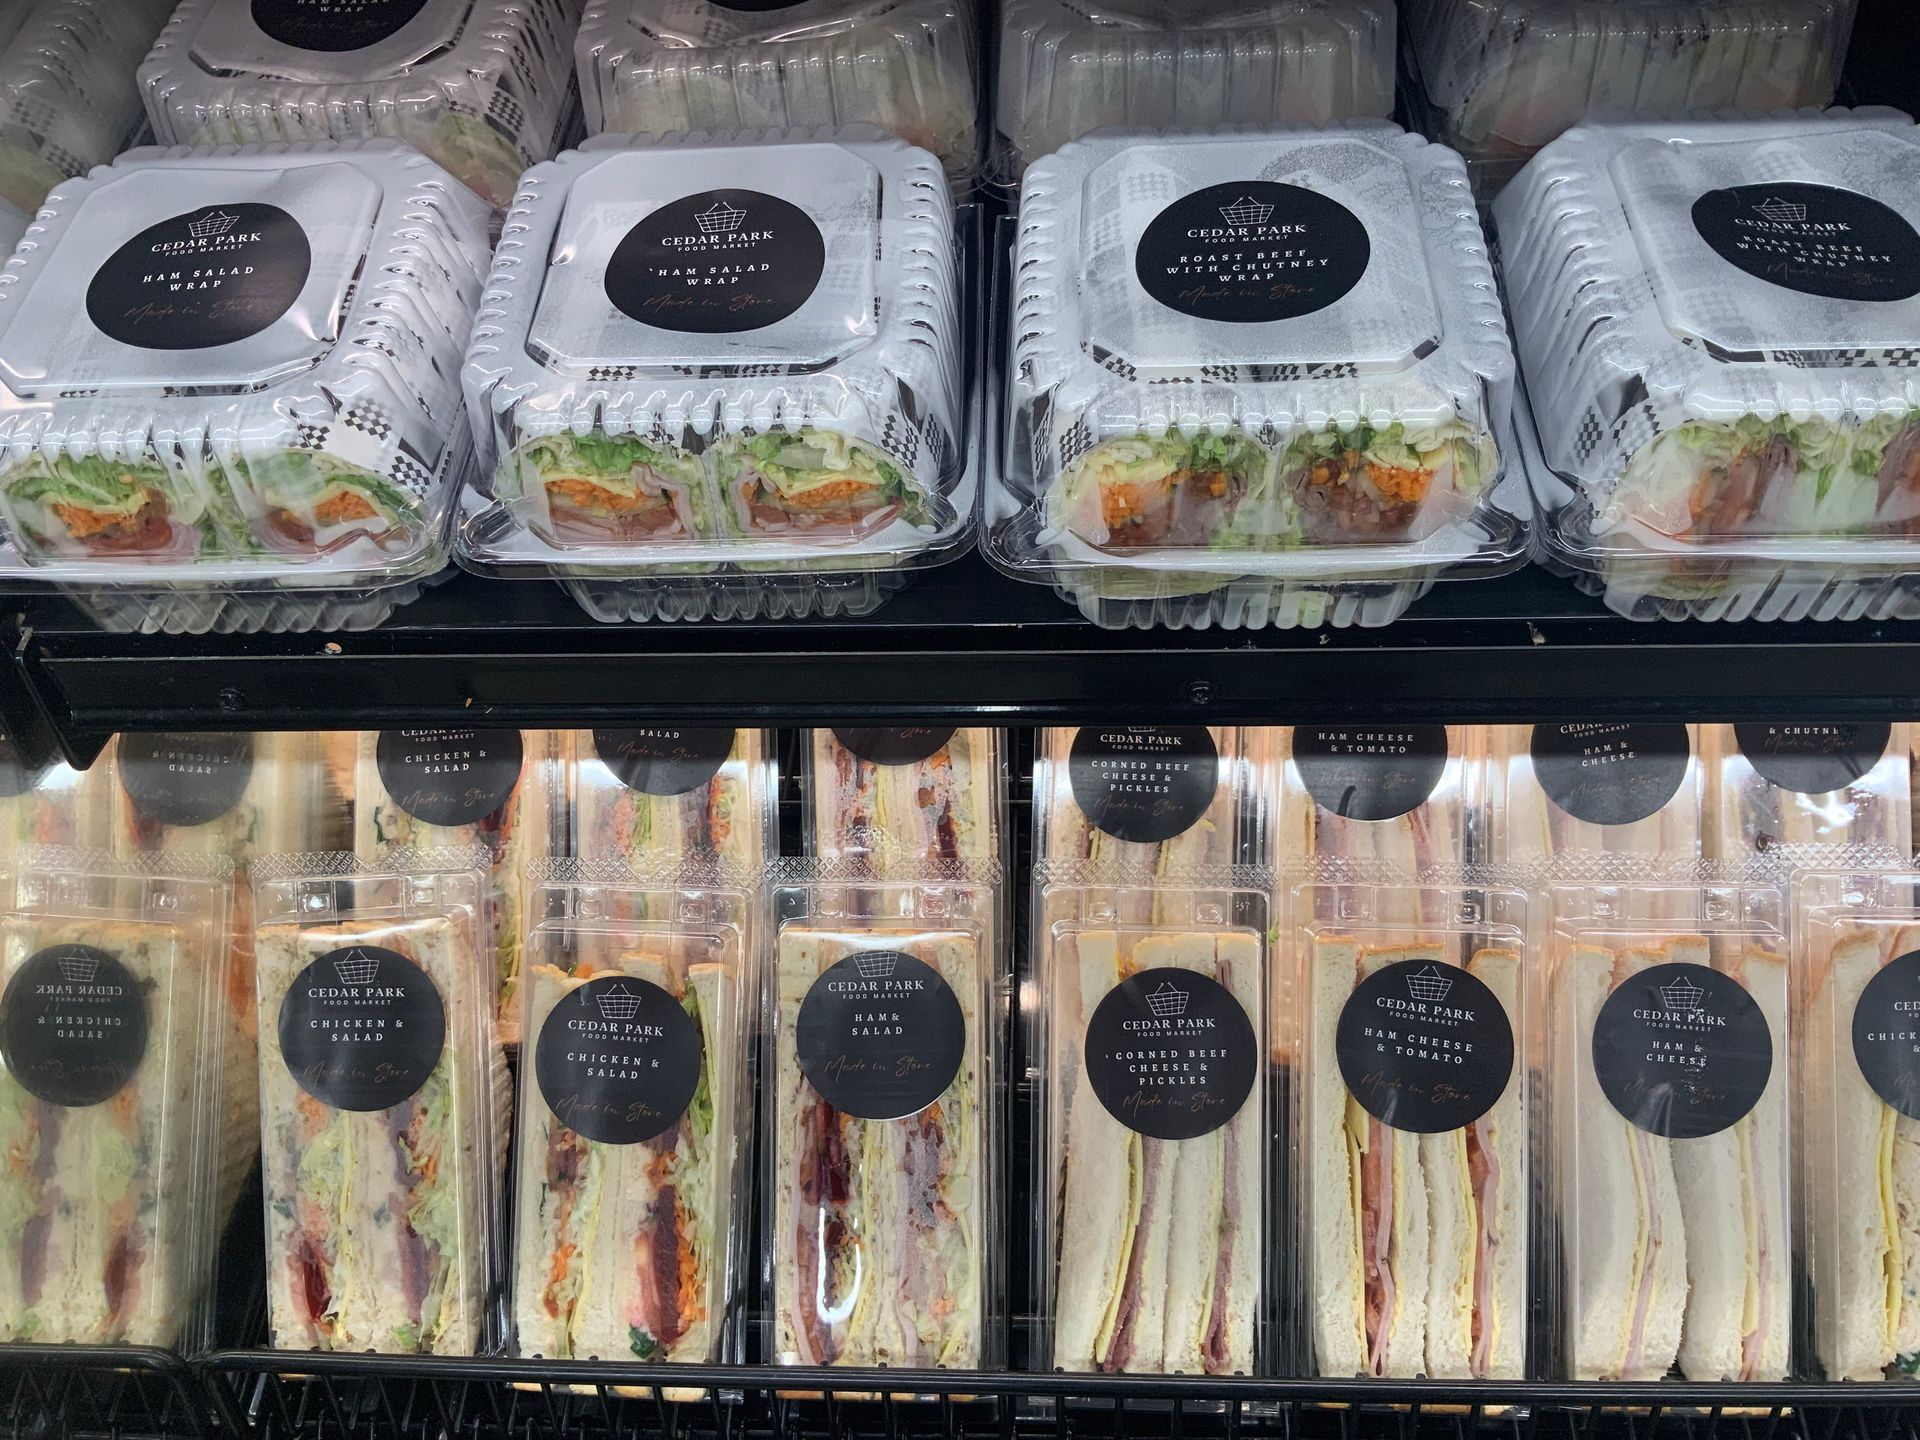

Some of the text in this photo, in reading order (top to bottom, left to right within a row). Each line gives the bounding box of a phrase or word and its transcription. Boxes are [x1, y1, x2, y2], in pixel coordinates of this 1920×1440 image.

[1734, 218, 1852, 231] CEDAR PARK
[1187, 224, 1307, 238] CEDAR PARK
[152, 232, 262, 252] CEDAR PARK
[662, 231, 775, 246] CEDAR PARK
[1243, 234, 1289, 242] MARKET
[1743, 235, 1863, 252] ROAST BEEF
[200, 244, 243, 252] MARKET
[713, 242, 756, 250] MARKET
[1180, 250, 1307, 263] ROAST BEEF
[1737, 242, 1891, 262] WITH CHUTNEY
[1167, 258, 1329, 275] WITH CHUTNEY
[1794, 256, 1846, 267] WRAP
[143, 266, 254, 283] HAM SALAD
[658, 263, 770, 277] HAM SALAD
[687, 276, 739, 286] WRAP
[1219, 273, 1274, 282] WRAP
[170, 280, 222, 291] WRAP
[640, 729, 680, 739] SALAD
[1574, 730, 1595, 739] FOOD
[1784, 727, 1839, 735] CHUTNE
[1100, 734, 1182, 745] CEDAR PARK
[1318, 732, 1414, 742] HAM CHEESE
[1347, 745, 1406, 754] TOMATO
[1584, 741, 1628, 755] HAM &
[406, 751, 470, 763] CHICKEN
[1582, 751, 1635, 767] CHEESE
[425, 763, 470, 774] SALAD
[1091, 760, 1190, 771] CORNED BEEF
[1103, 772, 1172, 782] CHEESE &
[1110, 784, 1169, 793] PICKLES
[828, 980, 925, 992] CEDAR PARK
[308, 987, 406, 998] CEDAR PARK
[1376, 996, 1476, 1022] CEDAR PARK
[1389, 1010, 1459, 1027] FOOD MARKET
[1633, 1009, 1726, 1026] CEDAR PARK
[310, 1019, 404, 1028] CHICKEN &
[568, 1019, 665, 1037] CEDAR PARK
[1122, 1018, 1216, 1030] CEDAR PARK
[1675, 1024, 1711, 1032] MARKET
[852, 1026, 903, 1036] SALAD
[331, 1033, 383, 1042] SALAD
[612, 1035, 650, 1043] MARKET
[1364, 1027, 1473, 1052] HAM CHEESE
[1652, 1041, 1703, 1053] HAM &
[1115, 1049, 1227, 1060] CORNED BEEF
[1376, 1043, 1463, 1064] & TOMATO
[1646, 1053, 1707, 1065] CHEESE
[567, 1052, 660, 1068] CHICKEN &
[587, 1068, 638, 1079] SALAD
[1129, 1063, 1208, 1073] CHEESE &
[1139, 1076, 1206, 1085] PICKLES
